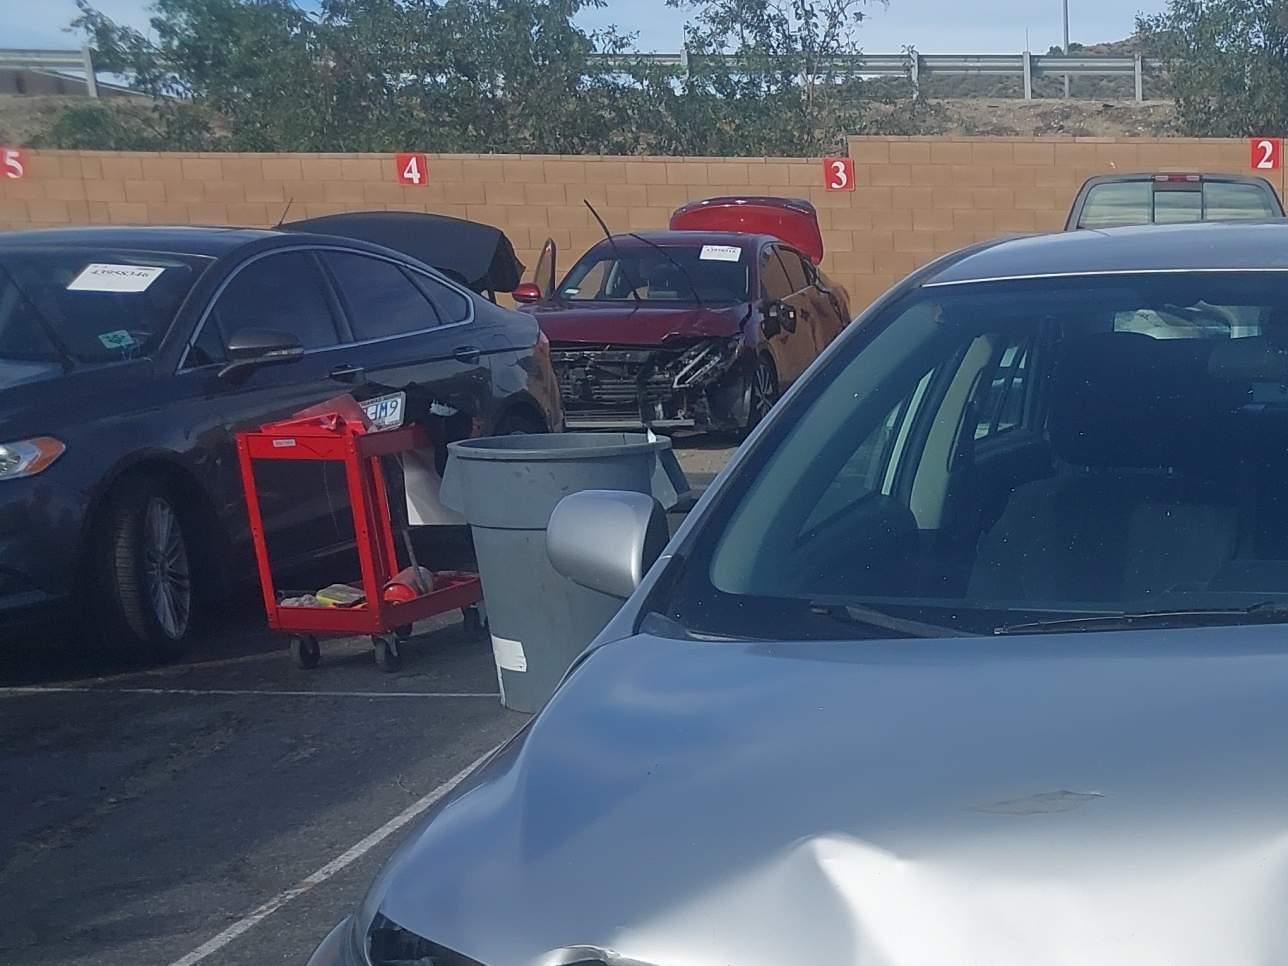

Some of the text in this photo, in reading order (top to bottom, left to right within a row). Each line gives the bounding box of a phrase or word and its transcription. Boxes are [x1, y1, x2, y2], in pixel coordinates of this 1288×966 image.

[5, 151, 24, 178] 5
[1256, 140, 1274, 169] 2
[403, 156, 421, 184] 4
[831, 160, 848, 189] 3
